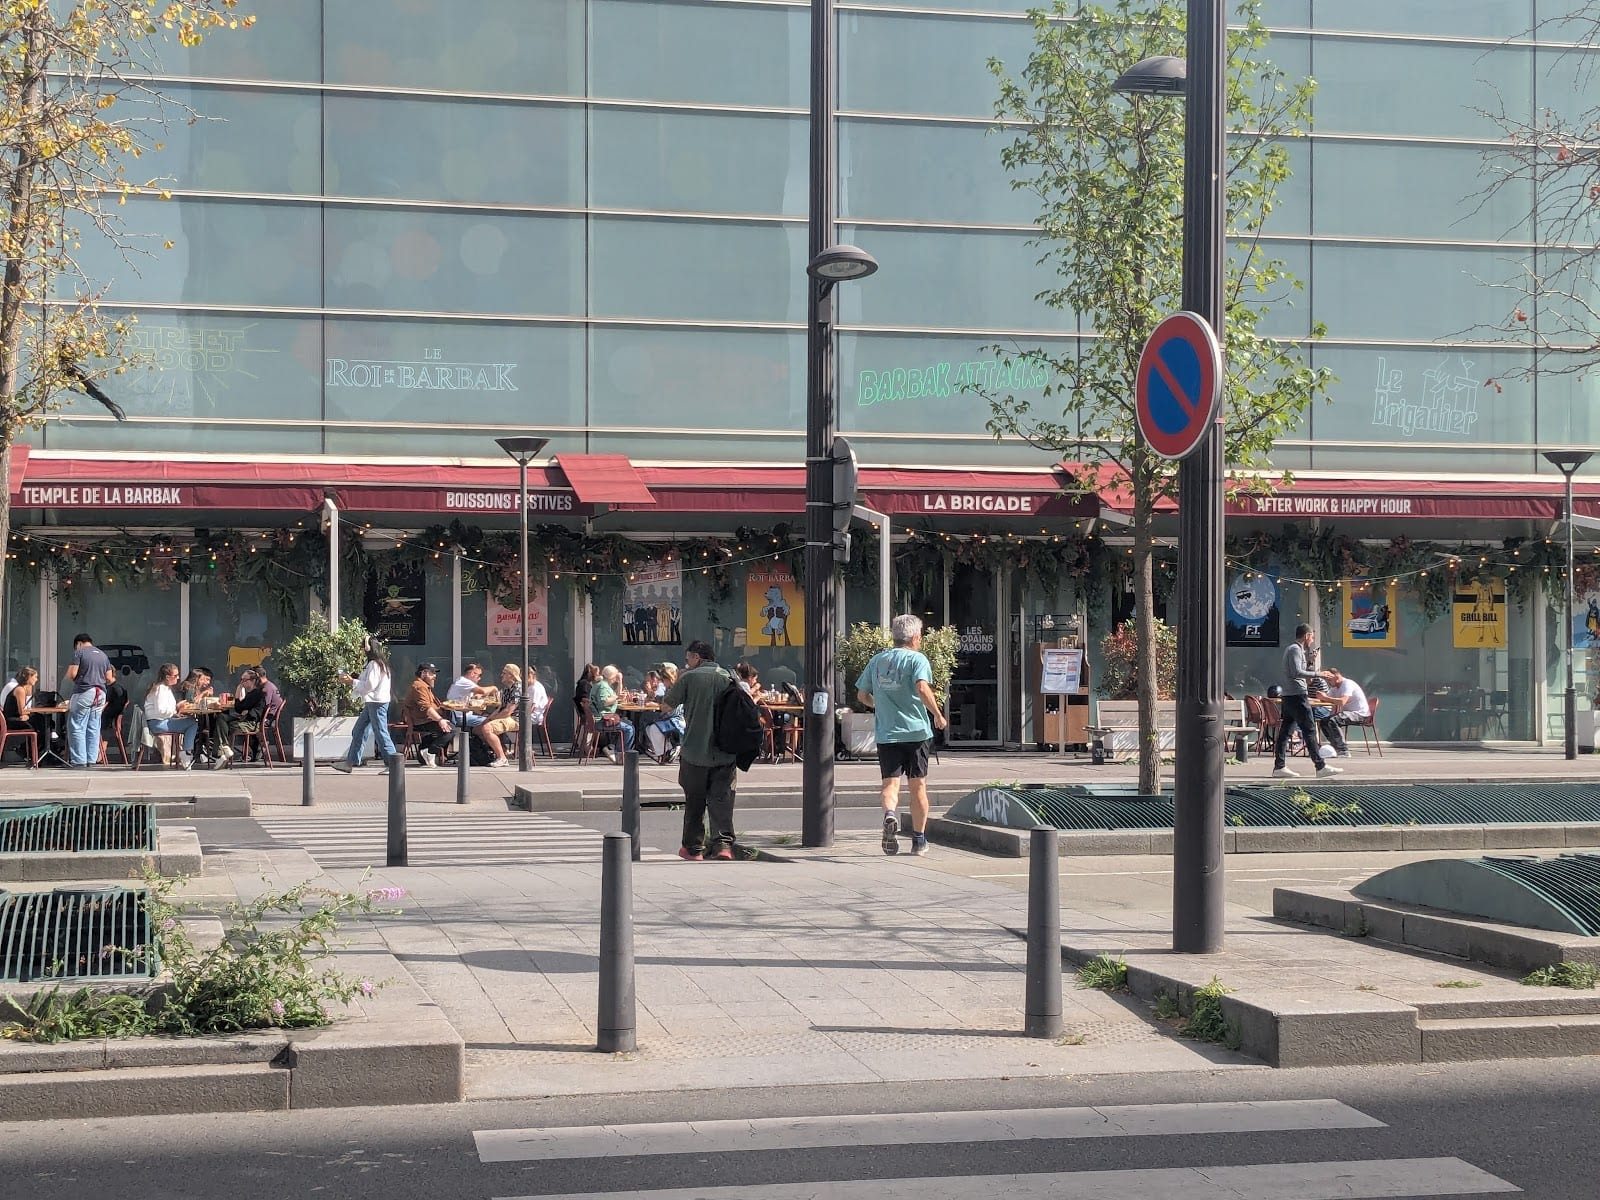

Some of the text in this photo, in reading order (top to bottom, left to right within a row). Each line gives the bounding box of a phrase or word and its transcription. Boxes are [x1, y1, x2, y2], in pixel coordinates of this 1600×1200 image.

[423, 348, 442, 360] LE
[326, 358, 382, 388] ROI
[397, 363, 520, 391] BARBAK
[857, 357, 1049, 407] BARBAK ATTACKS
[1375, 357, 1402, 392] Le
[1372, 390, 1478, 437] Brigadier
[23, 487, 182, 505] TEMPLE DE LA BARBAK
[446, 492, 572, 510] BOISSONS FSTIVES
[924, 495, 1032, 512] LA BRIGADE
[1257, 497, 1411, 514] AFTER WORK & HAPPY HOUR
[960, 634, 994, 643] OPAINS
[966, 626, 983, 635] LES
